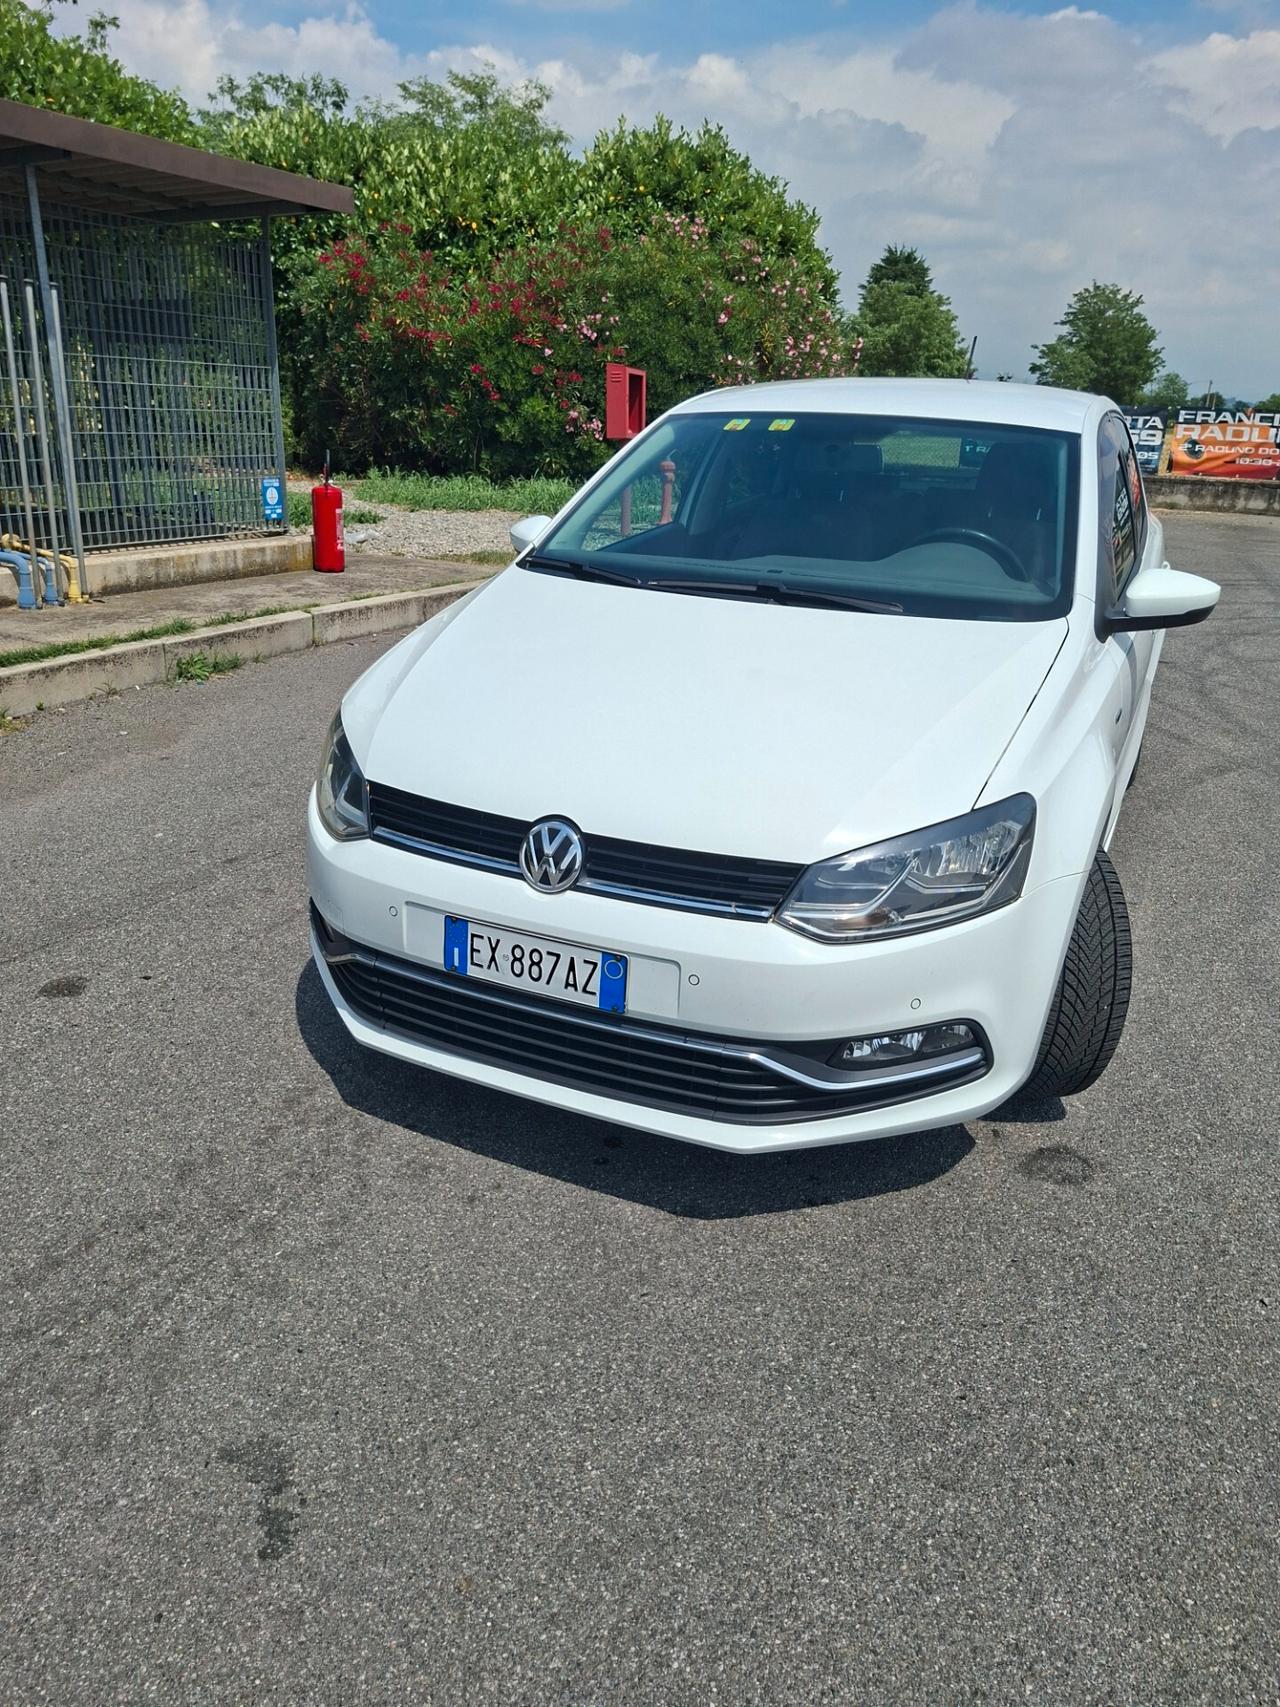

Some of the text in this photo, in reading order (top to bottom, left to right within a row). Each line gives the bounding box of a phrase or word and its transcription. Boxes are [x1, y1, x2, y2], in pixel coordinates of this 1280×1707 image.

[1194, 444, 1255, 454] RADUNO
[470, 933, 599, 995] EX 887AZ
